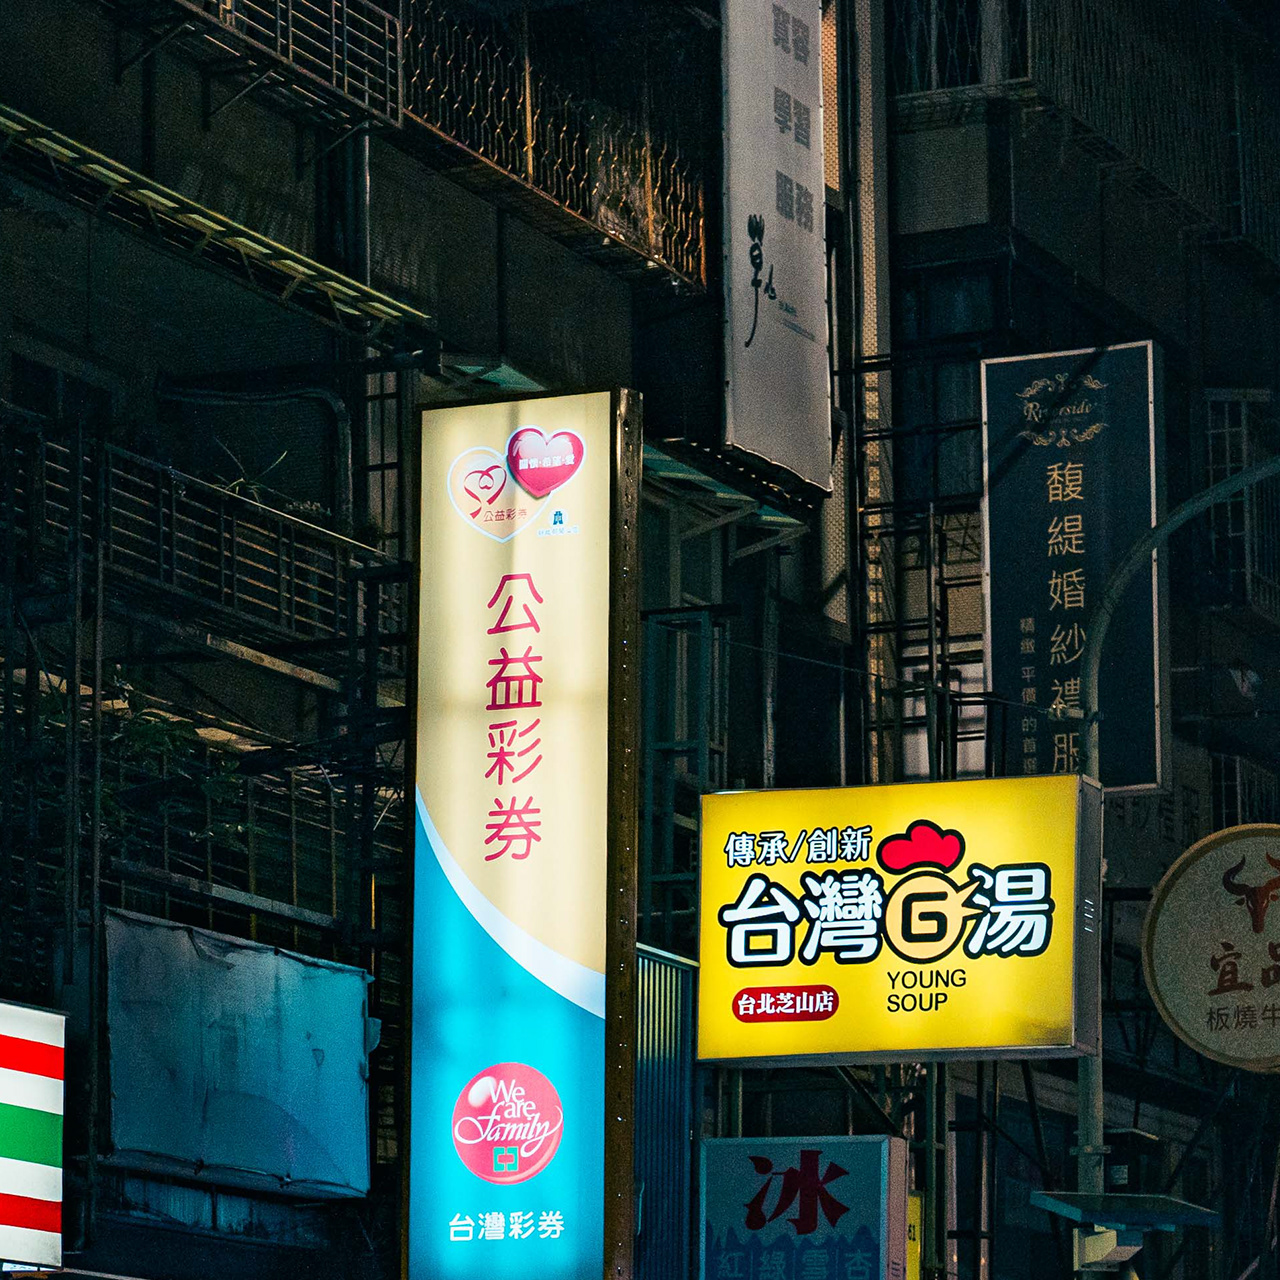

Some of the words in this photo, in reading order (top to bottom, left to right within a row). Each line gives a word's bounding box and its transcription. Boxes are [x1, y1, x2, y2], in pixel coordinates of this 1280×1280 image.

[1023, 398, 1092, 423] Rirside
[484, 573, 543, 862] 公益彩券
[724, 825, 872, 868] 傳承/創新
[887, 969, 966, 989] YOUNG
[737, 985, 833, 1016] 台北芝山店
[887, 992, 948, 1012] SOUP
[488, 1080, 526, 1104] We
[743, 1150, 850, 1235] 冰
[448, 1210, 565, 1242] 台灣彩券
